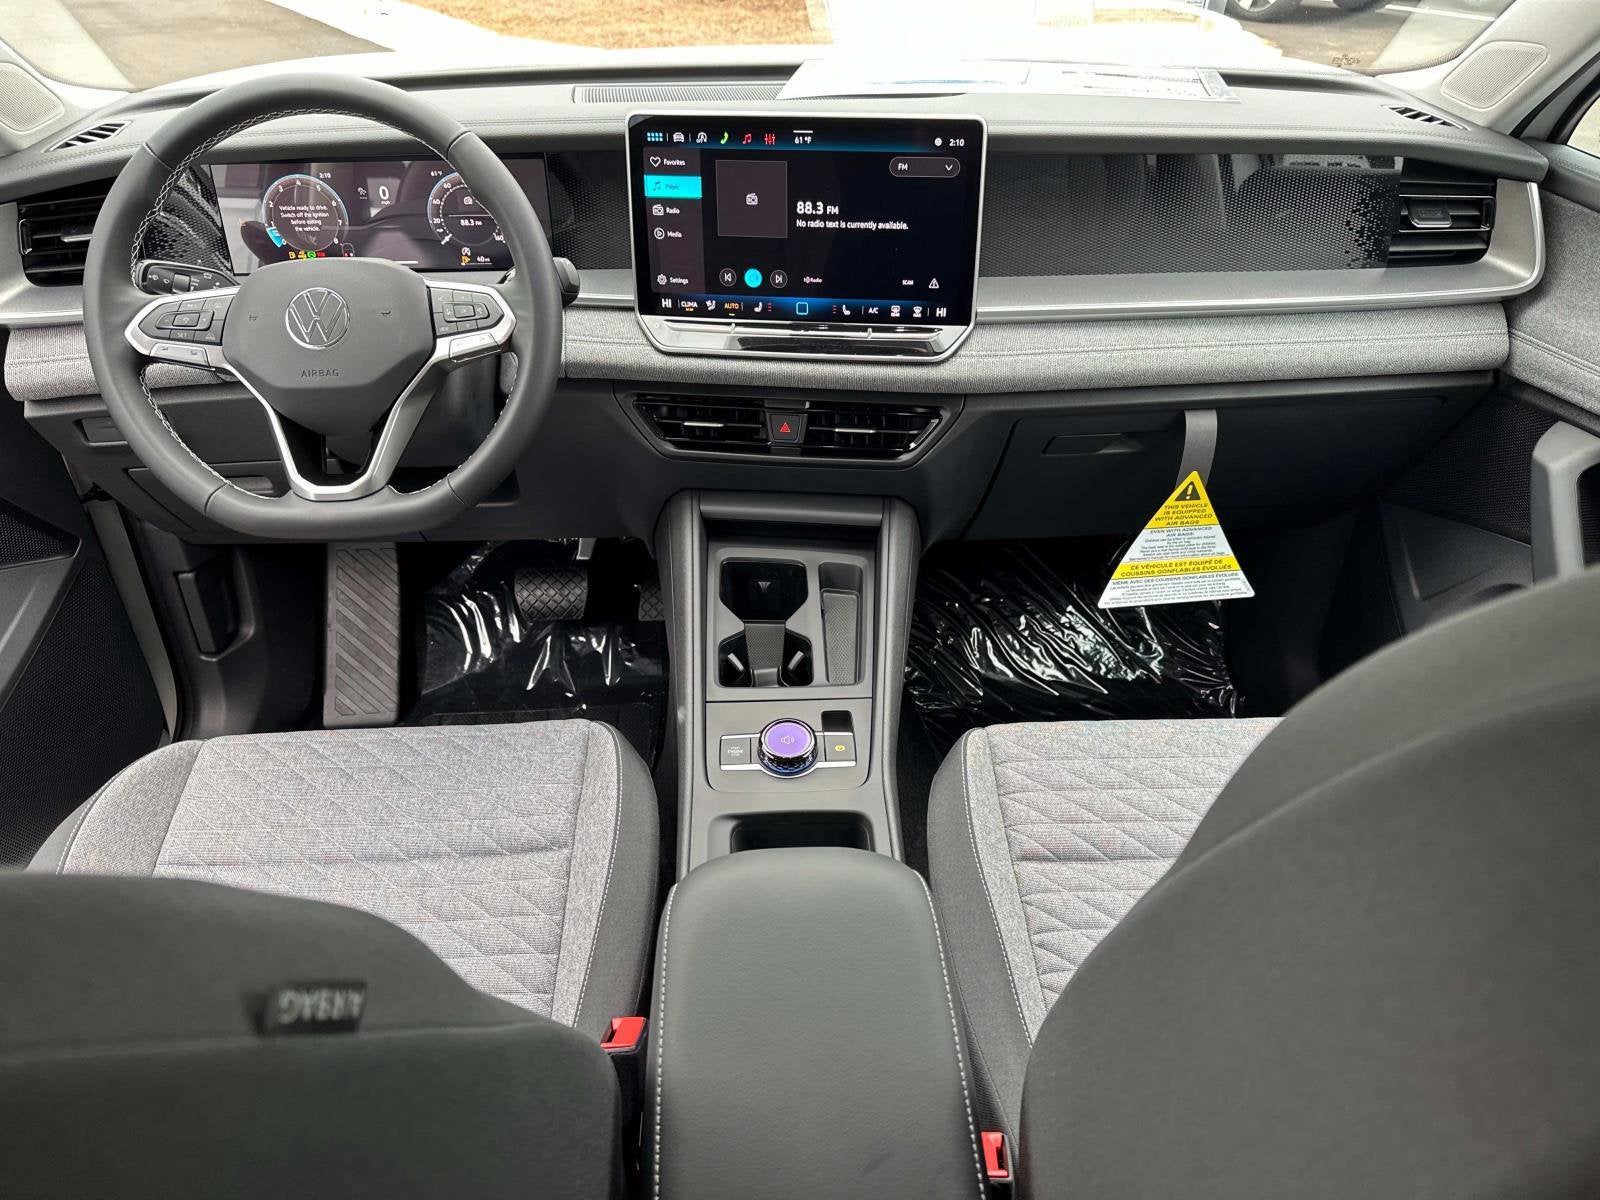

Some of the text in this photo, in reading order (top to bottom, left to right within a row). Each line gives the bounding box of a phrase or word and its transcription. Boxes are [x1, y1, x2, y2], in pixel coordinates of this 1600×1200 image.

[794, 136, 812, 145] 61 °F
[949, 139, 965, 147] 2:10
[897, 163, 909, 171] FM
[378, 186, 390, 200] 0
[666, 207, 681, 215] Radio
[796, 201, 840, 215] 88.3 FM
[460, 219, 475, 227] 88.3
[796, 219, 909, 231] No radio text is currently available.
[667, 230, 683, 238] Media
[669, 277, 689, 285] Settings
[661, 298, 672, 309] HI
[680, 300, 698, 308] CLIMA
[723, 302, 740, 310] AUTO
[867, 306, 879, 315] A/C
[935, 307, 947, 318] HI
[301, 368, 339, 378] AIRBAG
[1171, 508, 1207, 516] EQUIPPED
[1173, 513, 1213, 521] ADVANCED
[1140, 562, 1174, 570] VÉHICULE
[1120, 563, 1232, 578] COUSSINS GONFLABLES ÉVOLUÉS
